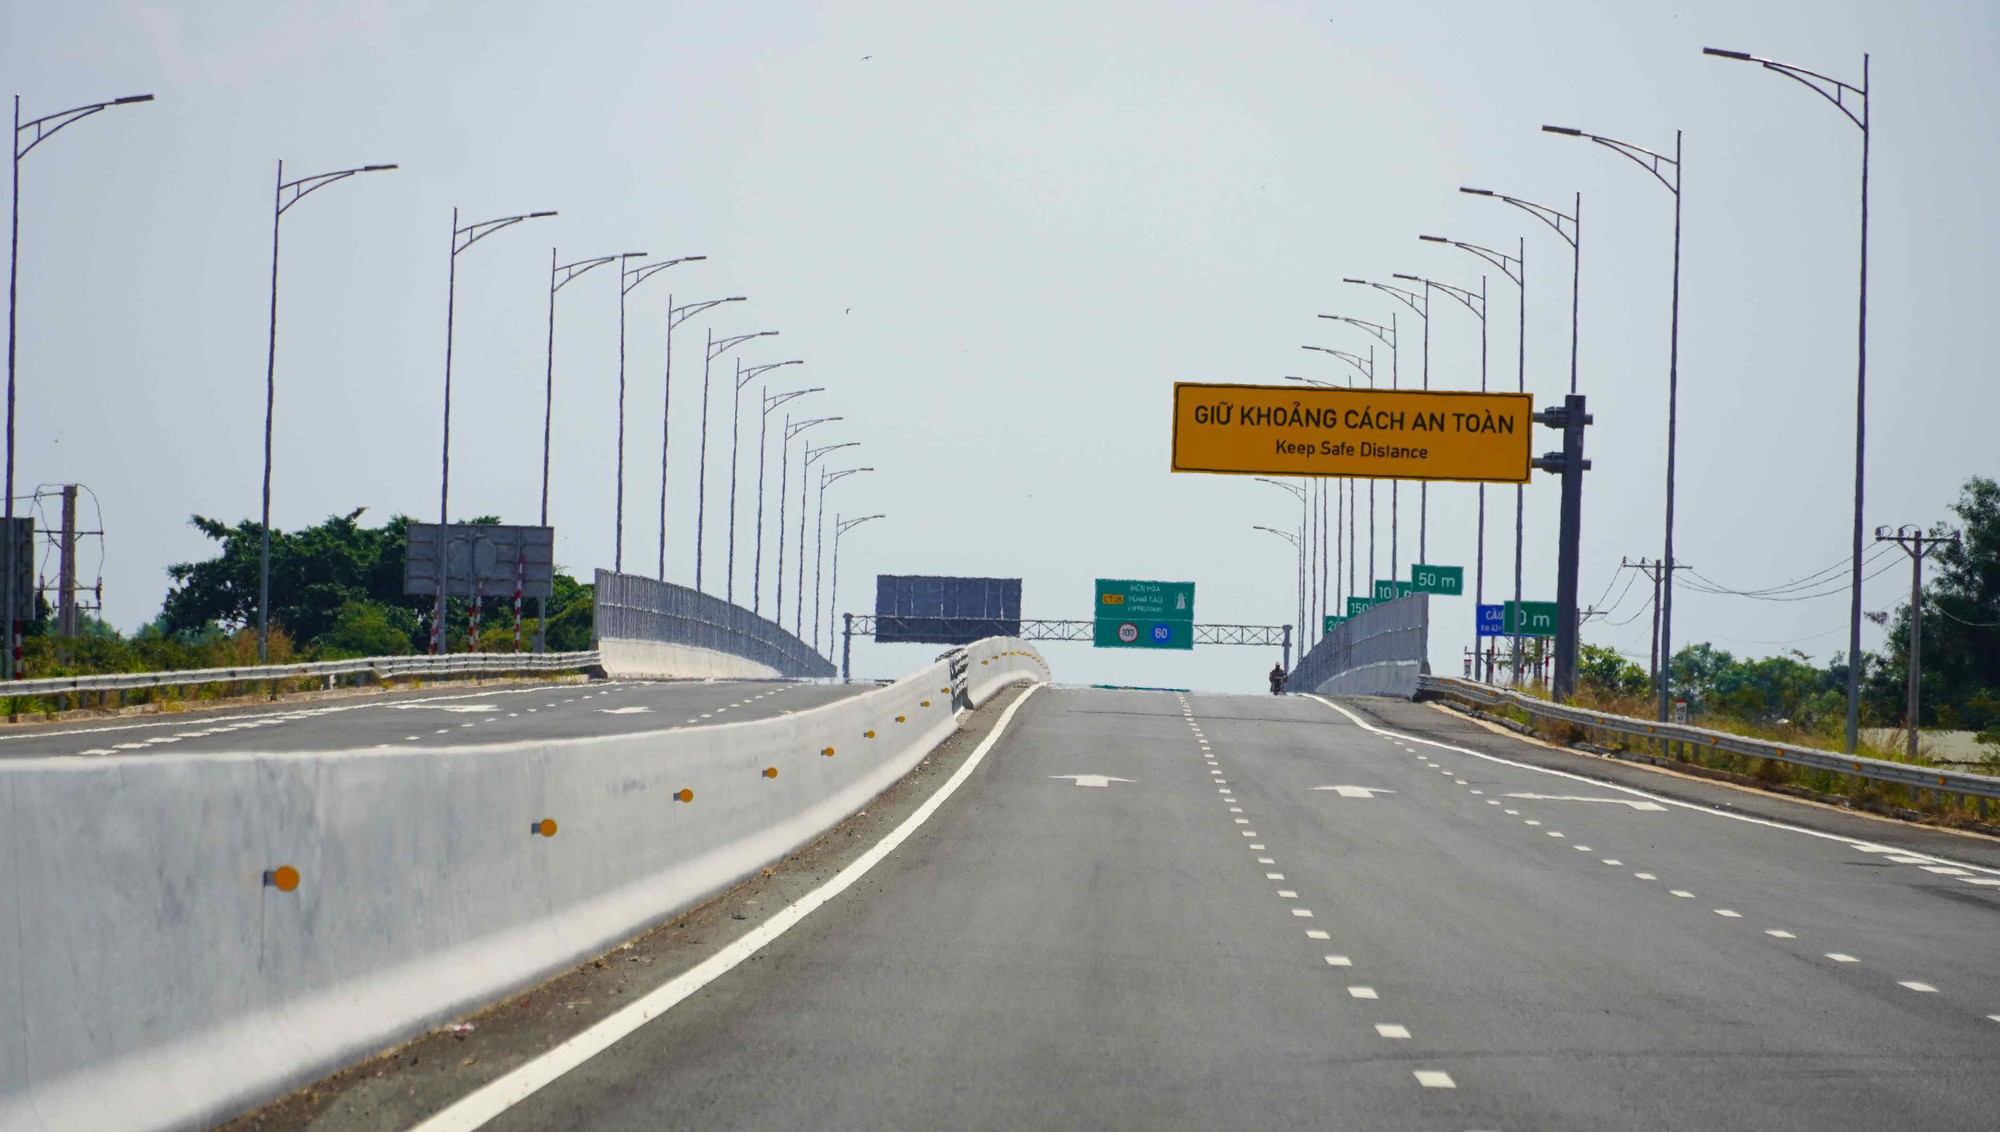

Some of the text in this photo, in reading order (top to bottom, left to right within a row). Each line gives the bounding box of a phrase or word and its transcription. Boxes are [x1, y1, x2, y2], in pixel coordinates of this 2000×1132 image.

[1194, 401, 1514, 434] GIỮ KHOẢNG CÁCH AN TOÀN
[1276, 439, 1428, 459] Keep Safe Distance
[1418, 573, 1455, 588] 50 m
[1532, 614, 1550, 627] m
